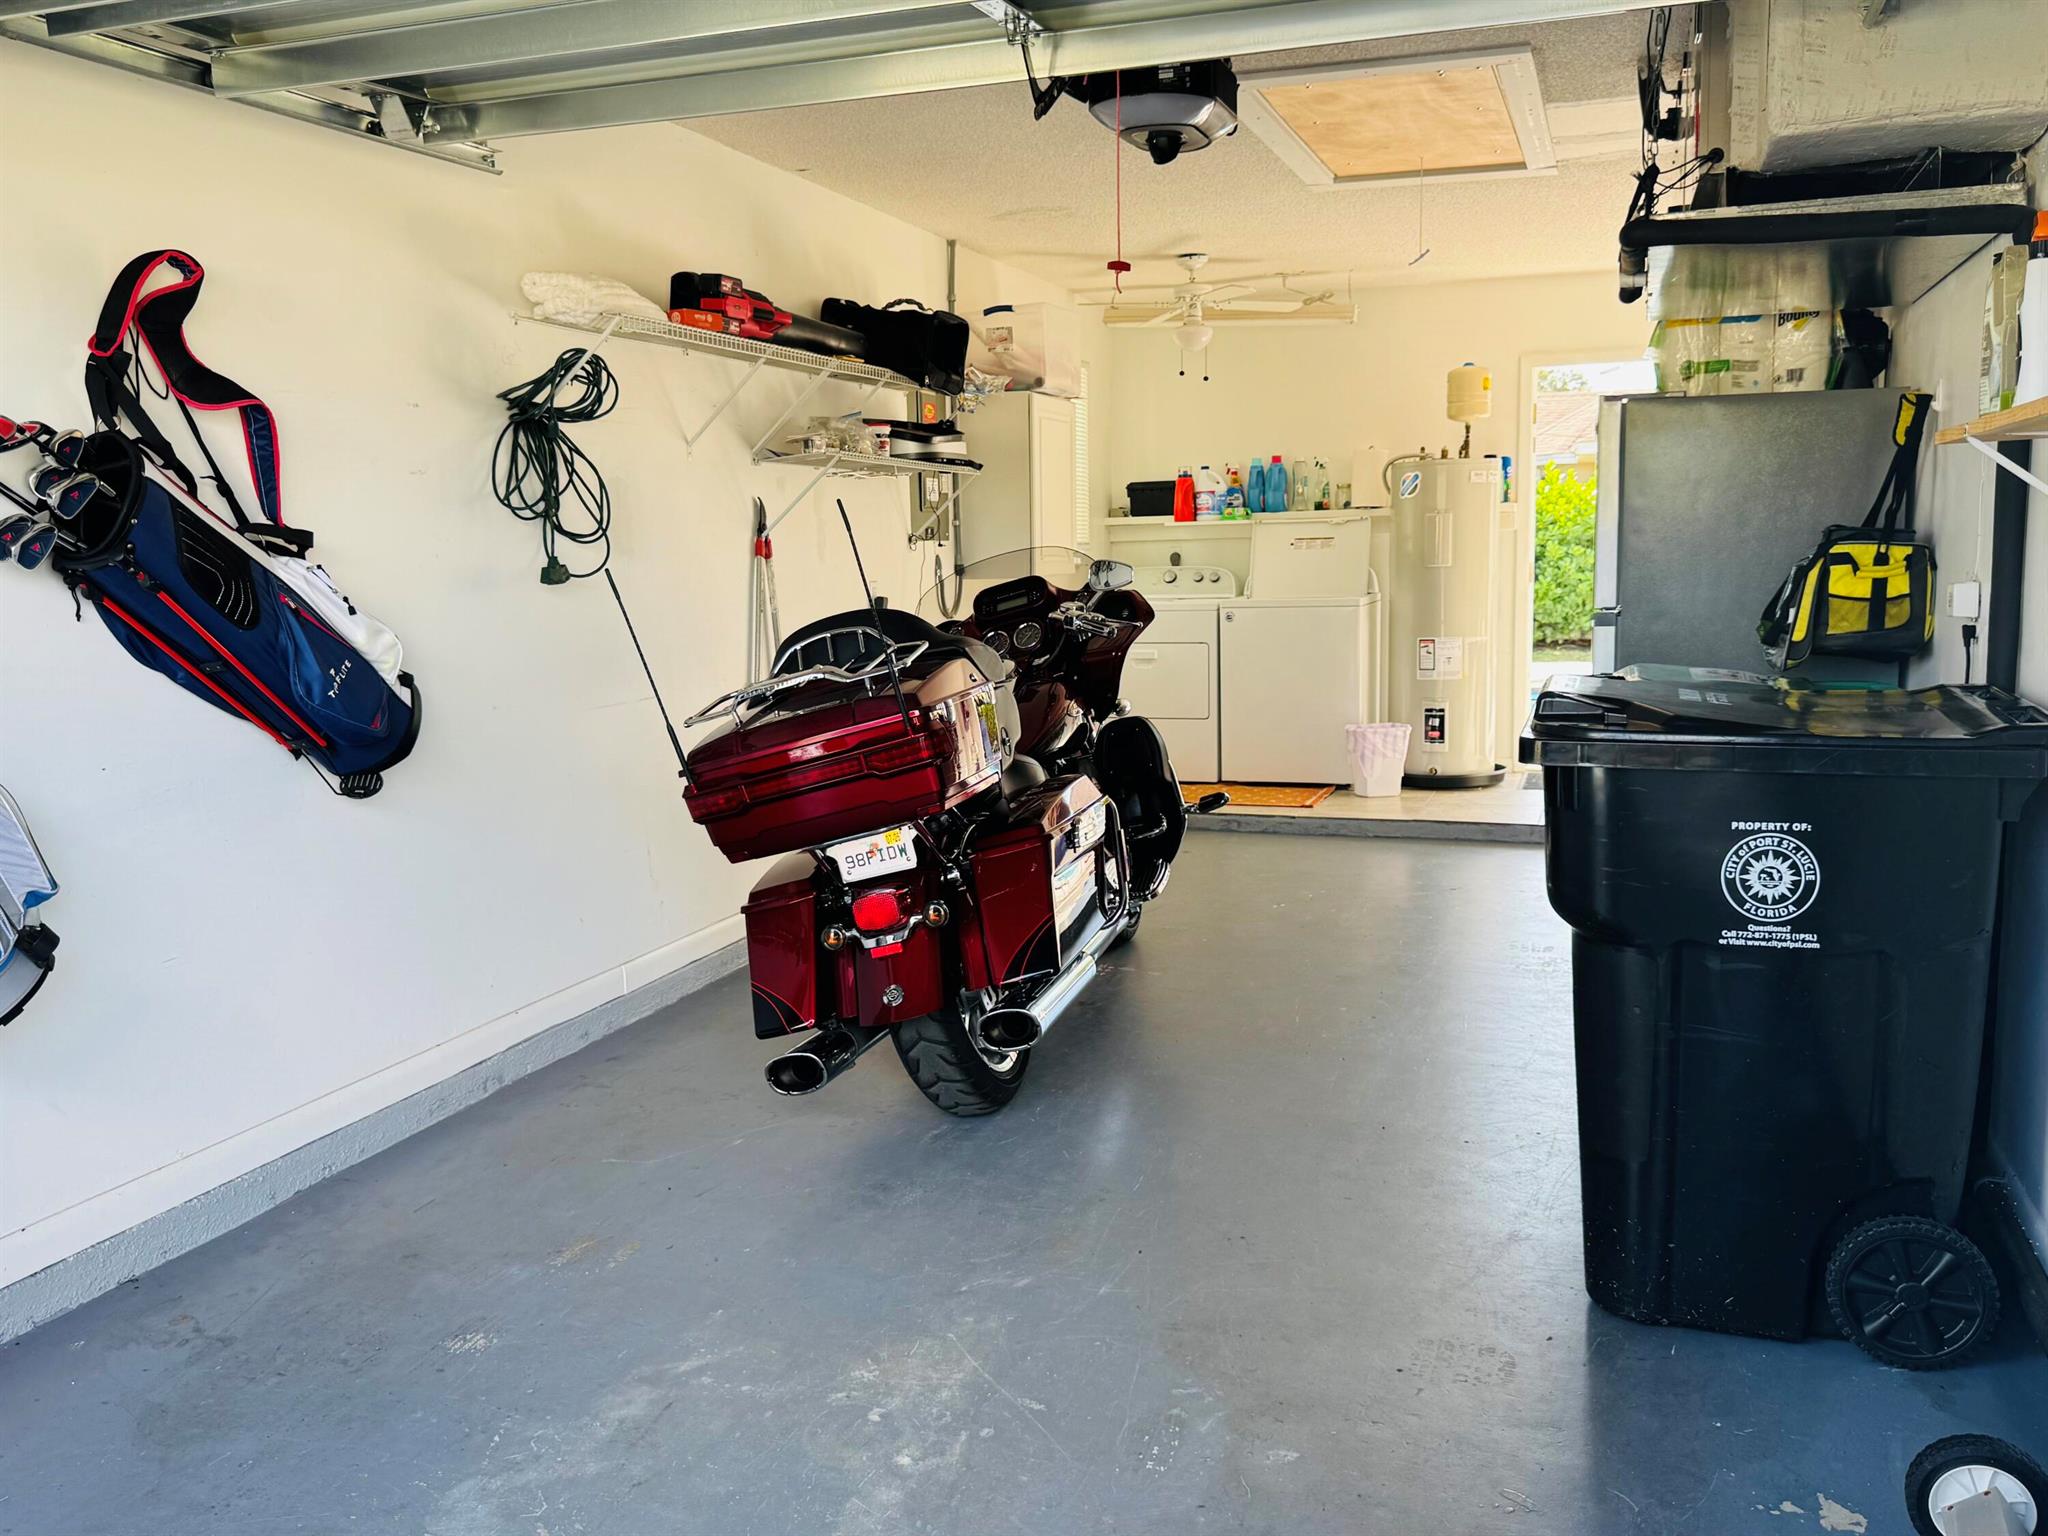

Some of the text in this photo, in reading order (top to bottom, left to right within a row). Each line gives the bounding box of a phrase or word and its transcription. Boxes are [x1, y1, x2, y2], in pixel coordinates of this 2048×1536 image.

[1731, 821, 1812, 832] PROPERTY OF:
[1725, 838, 1816, 881] CITY of PORT ST. LUCIE
[1743, 903, 1797, 917] FLORIDA
[1747, 924, 1791, 932] Questions?
[1721, 930, 1817, 942] Call 772-871-1775 (1PSL)
[1728, 938, 1745, 946] Visit
[1746, 940, 1820, 949] www.cityofpsl.com
